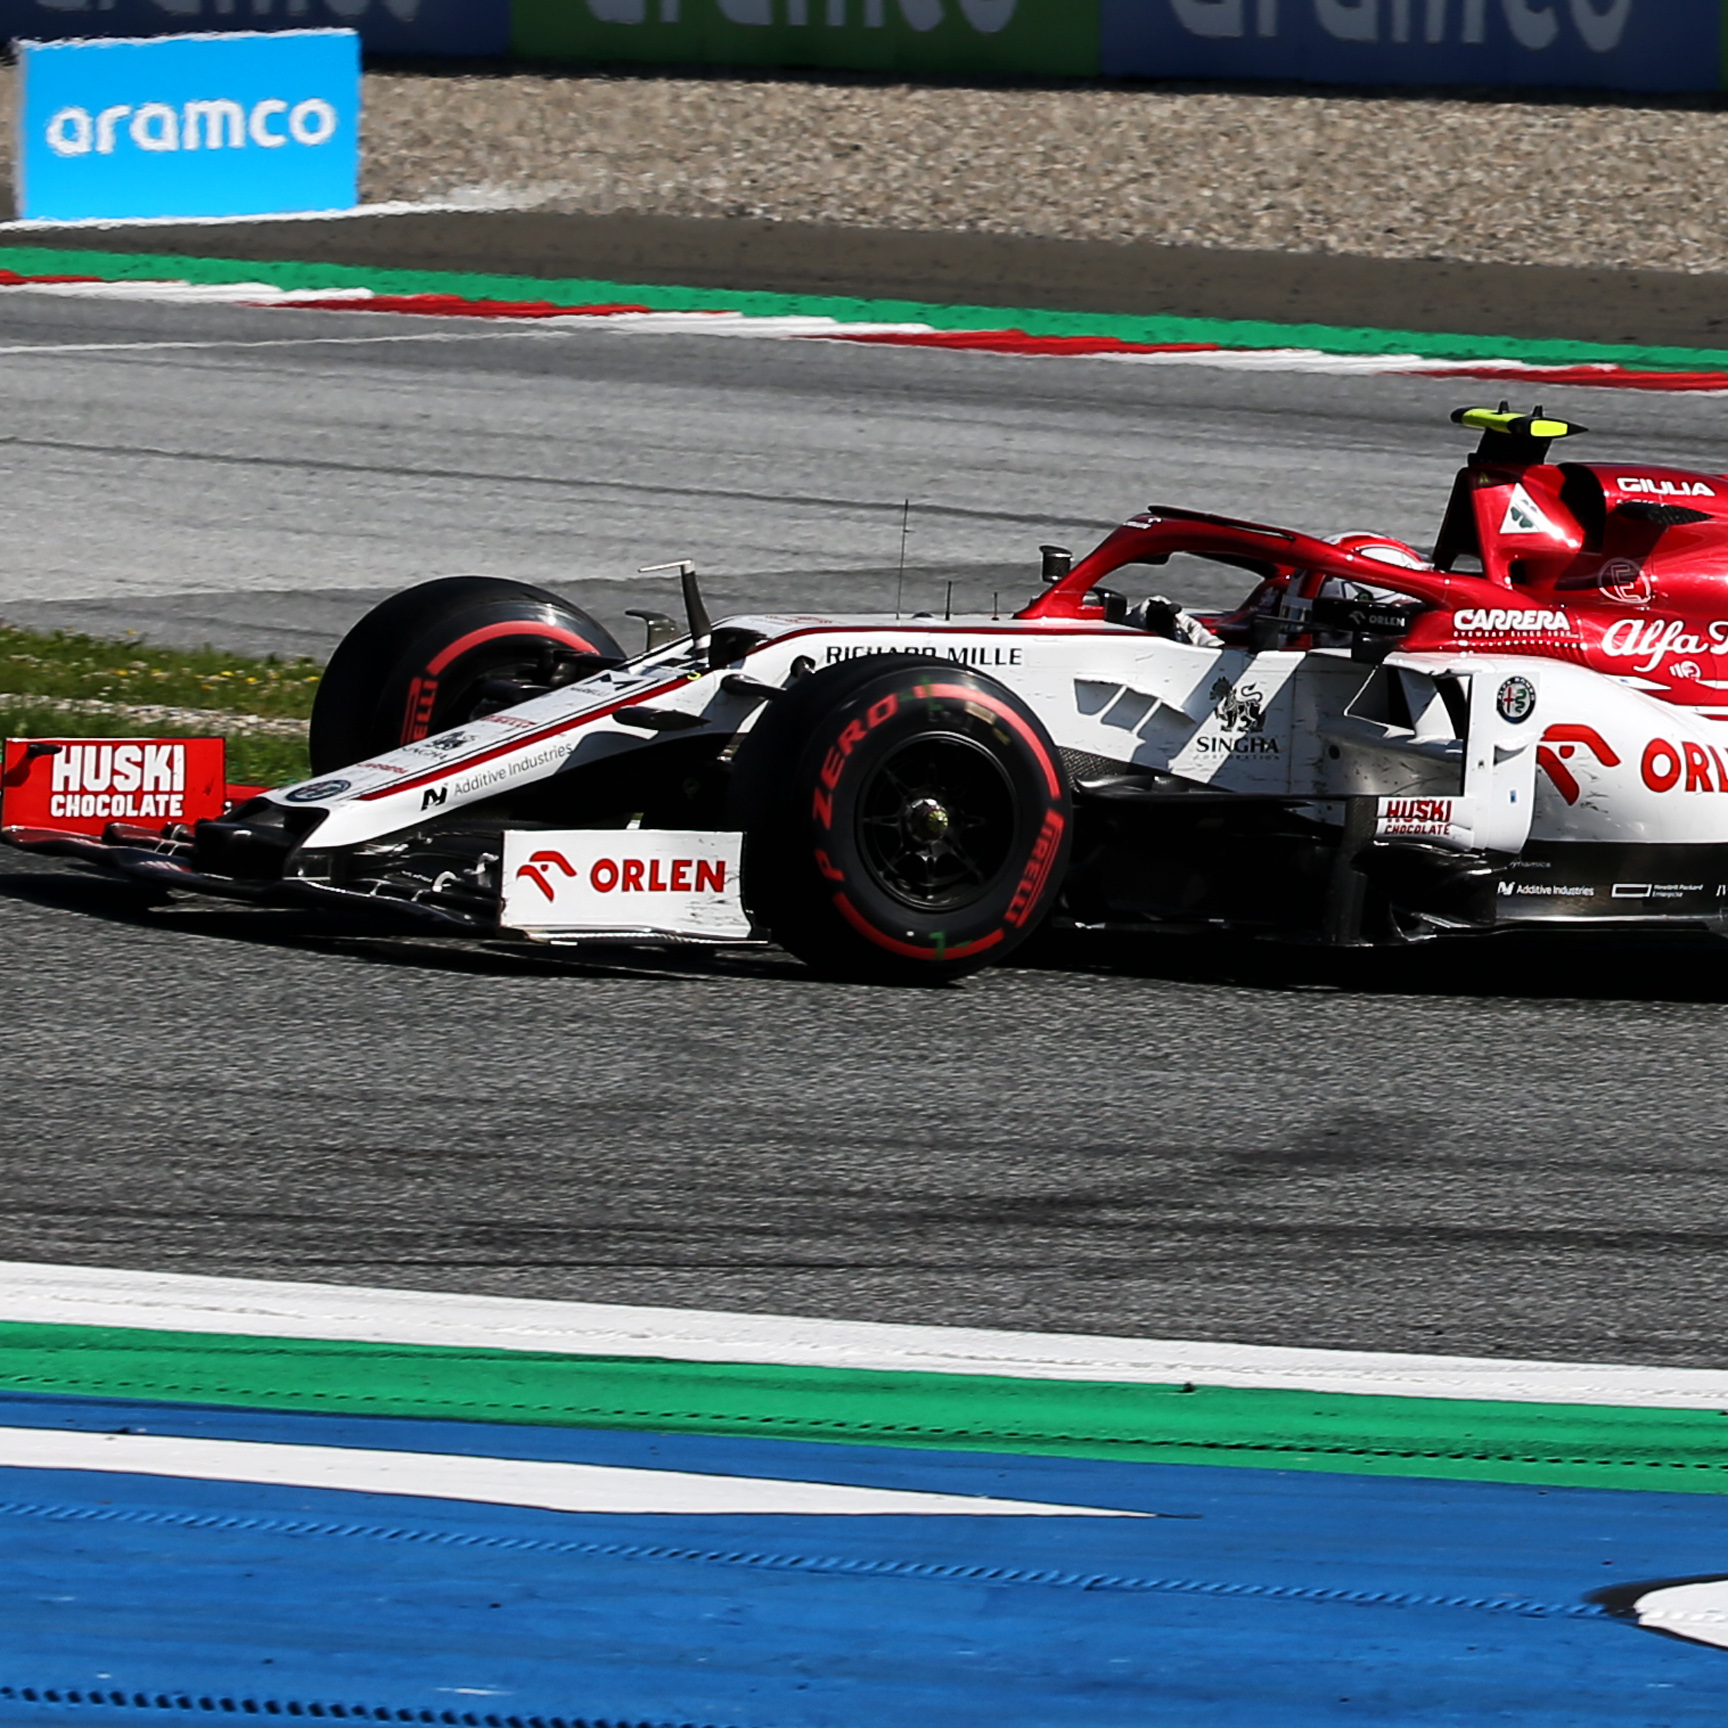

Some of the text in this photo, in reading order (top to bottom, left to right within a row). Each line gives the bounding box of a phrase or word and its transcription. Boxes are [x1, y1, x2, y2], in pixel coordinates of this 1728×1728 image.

[46, 97, 336, 156] aramco
[1616, 476, 1716, 496] GIULIA
[1369, 615, 1405, 627] ORLEN
[1454, 609, 1571, 630] CARRERA
[1601, 618, 1708, 672] Alfa
[950, 647, 1022, 666] MILLE
[1196, 736, 1279, 753] SINGHA
[52, 745, 184, 791] HUSKI
[454, 742, 572, 796] Additive Industries
[813, 692, 899, 830] ZERO
[51, 795, 183, 817] CHOCOLATE
[1387, 800, 1452, 822] HUSKI
[1384, 823, 1450, 836] CHOCOLATE
[590, 859, 726, 892] ORLEN
[1004, 808, 1065, 928] PIRELLI
[1516, 884, 1595, 897] Additive Industries
